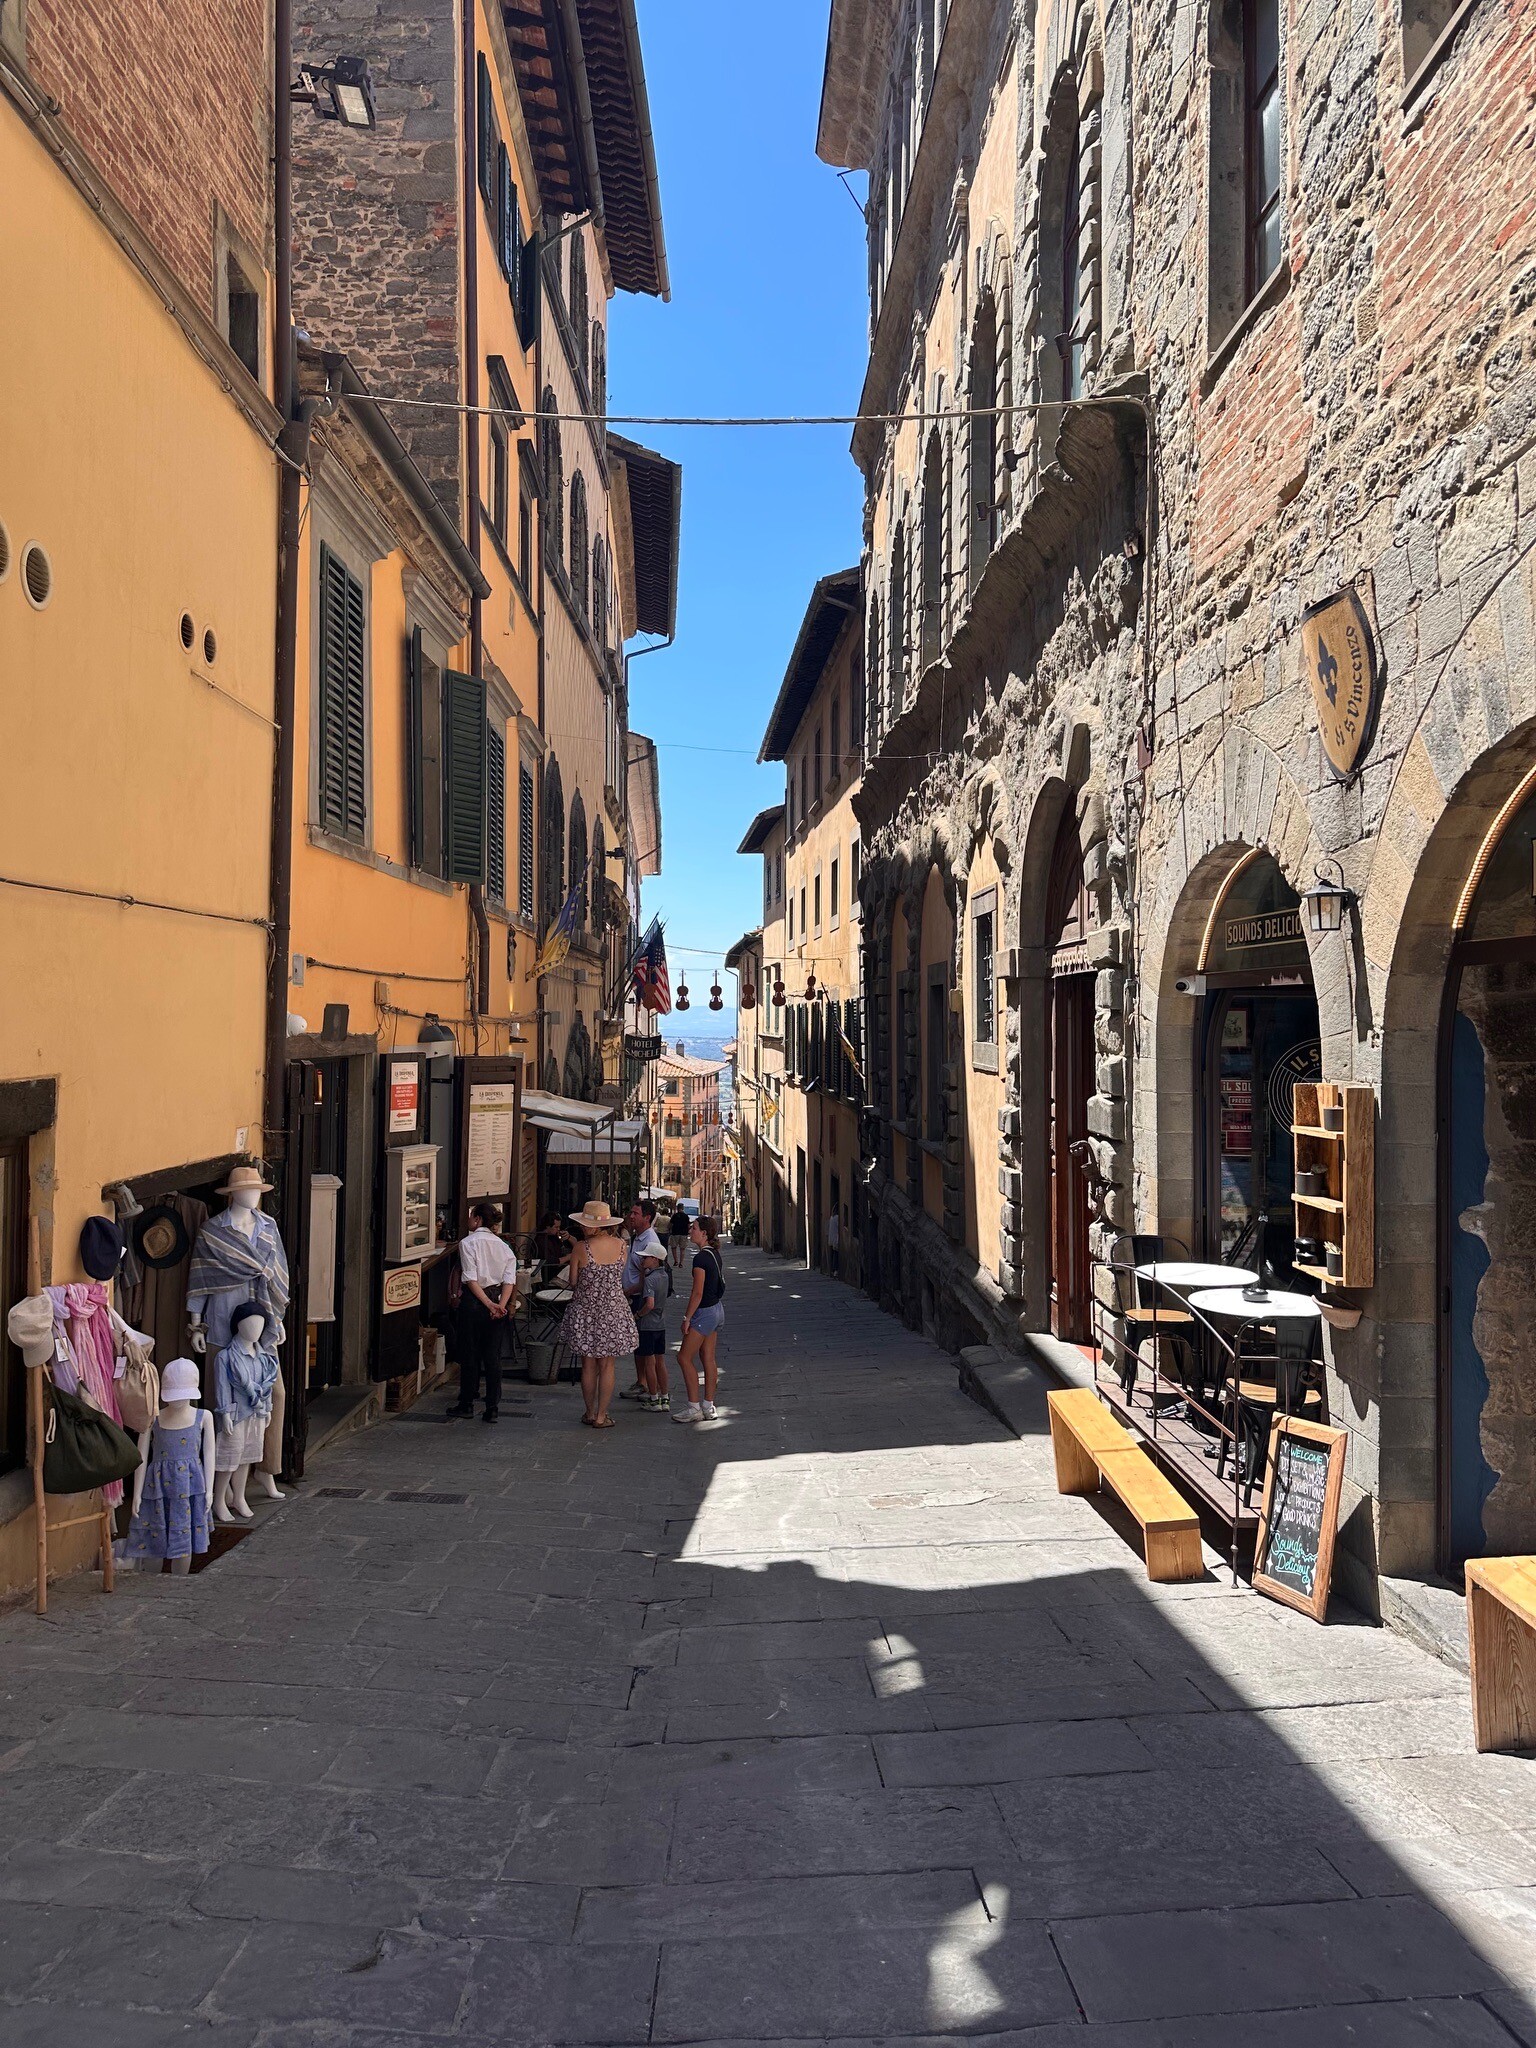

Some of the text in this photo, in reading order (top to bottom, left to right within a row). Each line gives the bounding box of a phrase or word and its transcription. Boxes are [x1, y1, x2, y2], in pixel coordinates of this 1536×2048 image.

[1345, 625, 1364, 720] Vincenzo
[1227, 920, 1263, 944] SOUNDS
[631, 1040, 655, 1049] HOTEL
[1290, 1056, 1309, 1071] IL
[1290, 1448, 1323, 1465] WELCOME
[1282, 1506, 1296, 1522] GOOD
[1296, 1509, 1317, 1529] DRINKS
